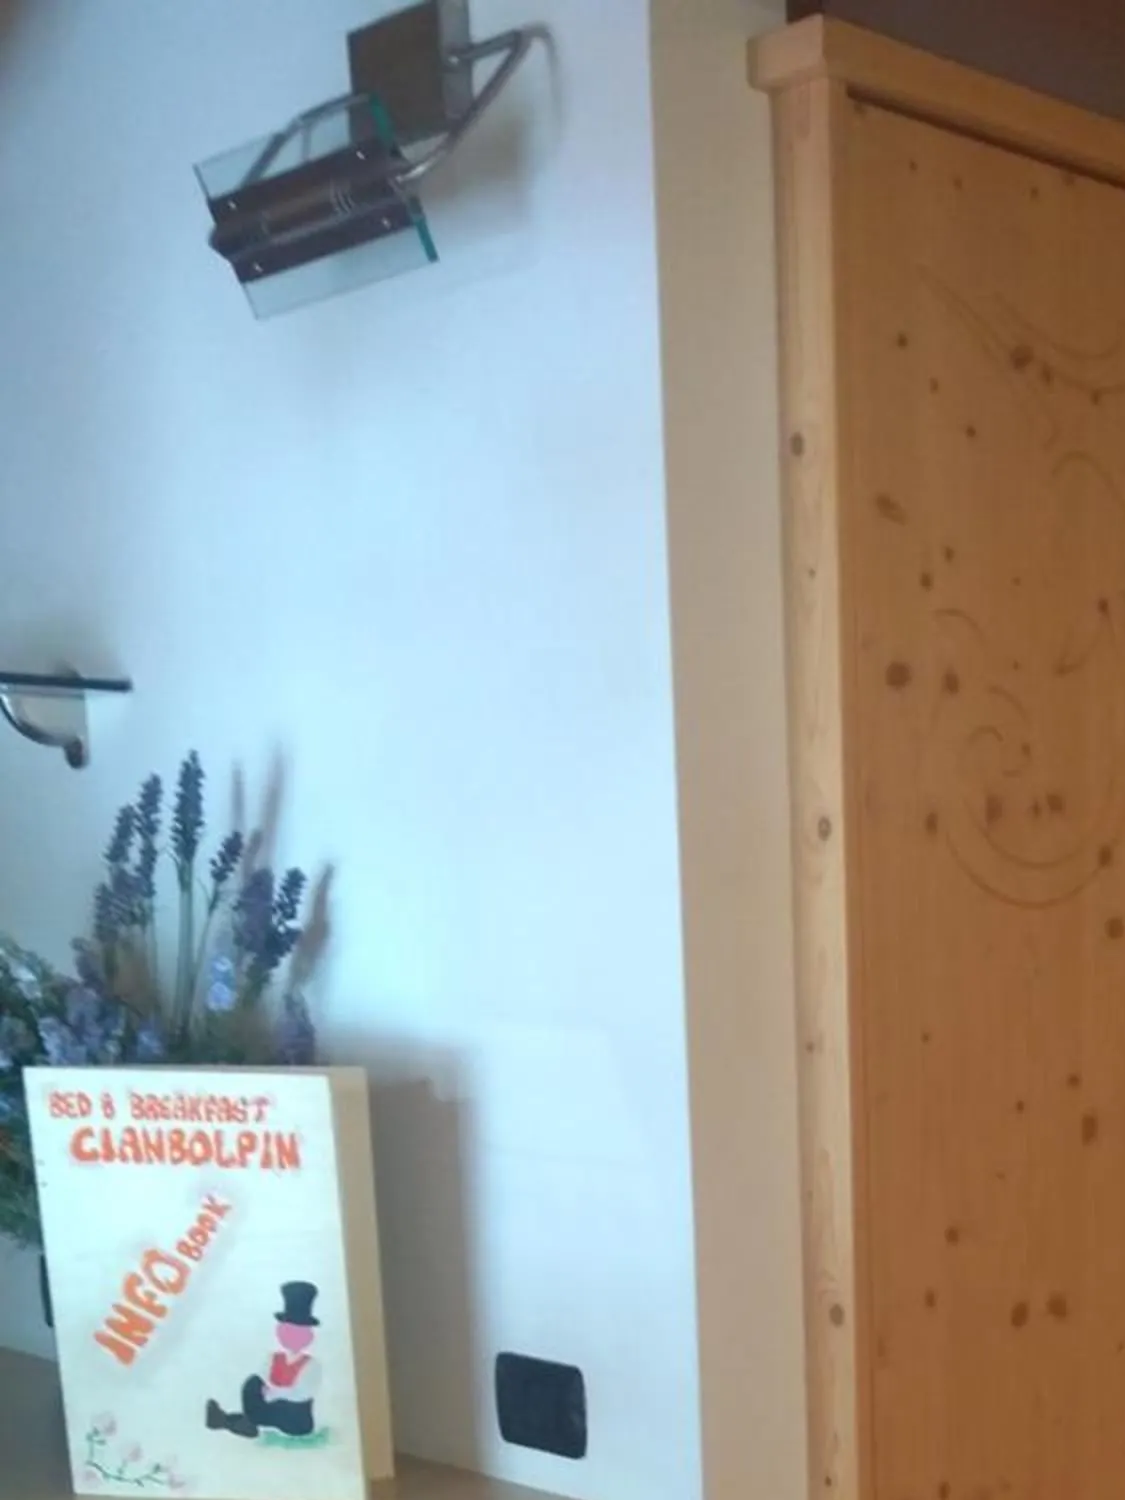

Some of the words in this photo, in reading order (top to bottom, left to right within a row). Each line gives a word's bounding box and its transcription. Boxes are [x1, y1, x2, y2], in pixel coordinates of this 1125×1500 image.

[49, 1091, 92, 1118] BED
[130, 1091, 270, 1123] BREAKFAST
[70, 1126, 301, 1169] CIANBOLPIN
[94, 1248, 191, 1366] INFO
[176, 1193, 232, 1262] BOOK
